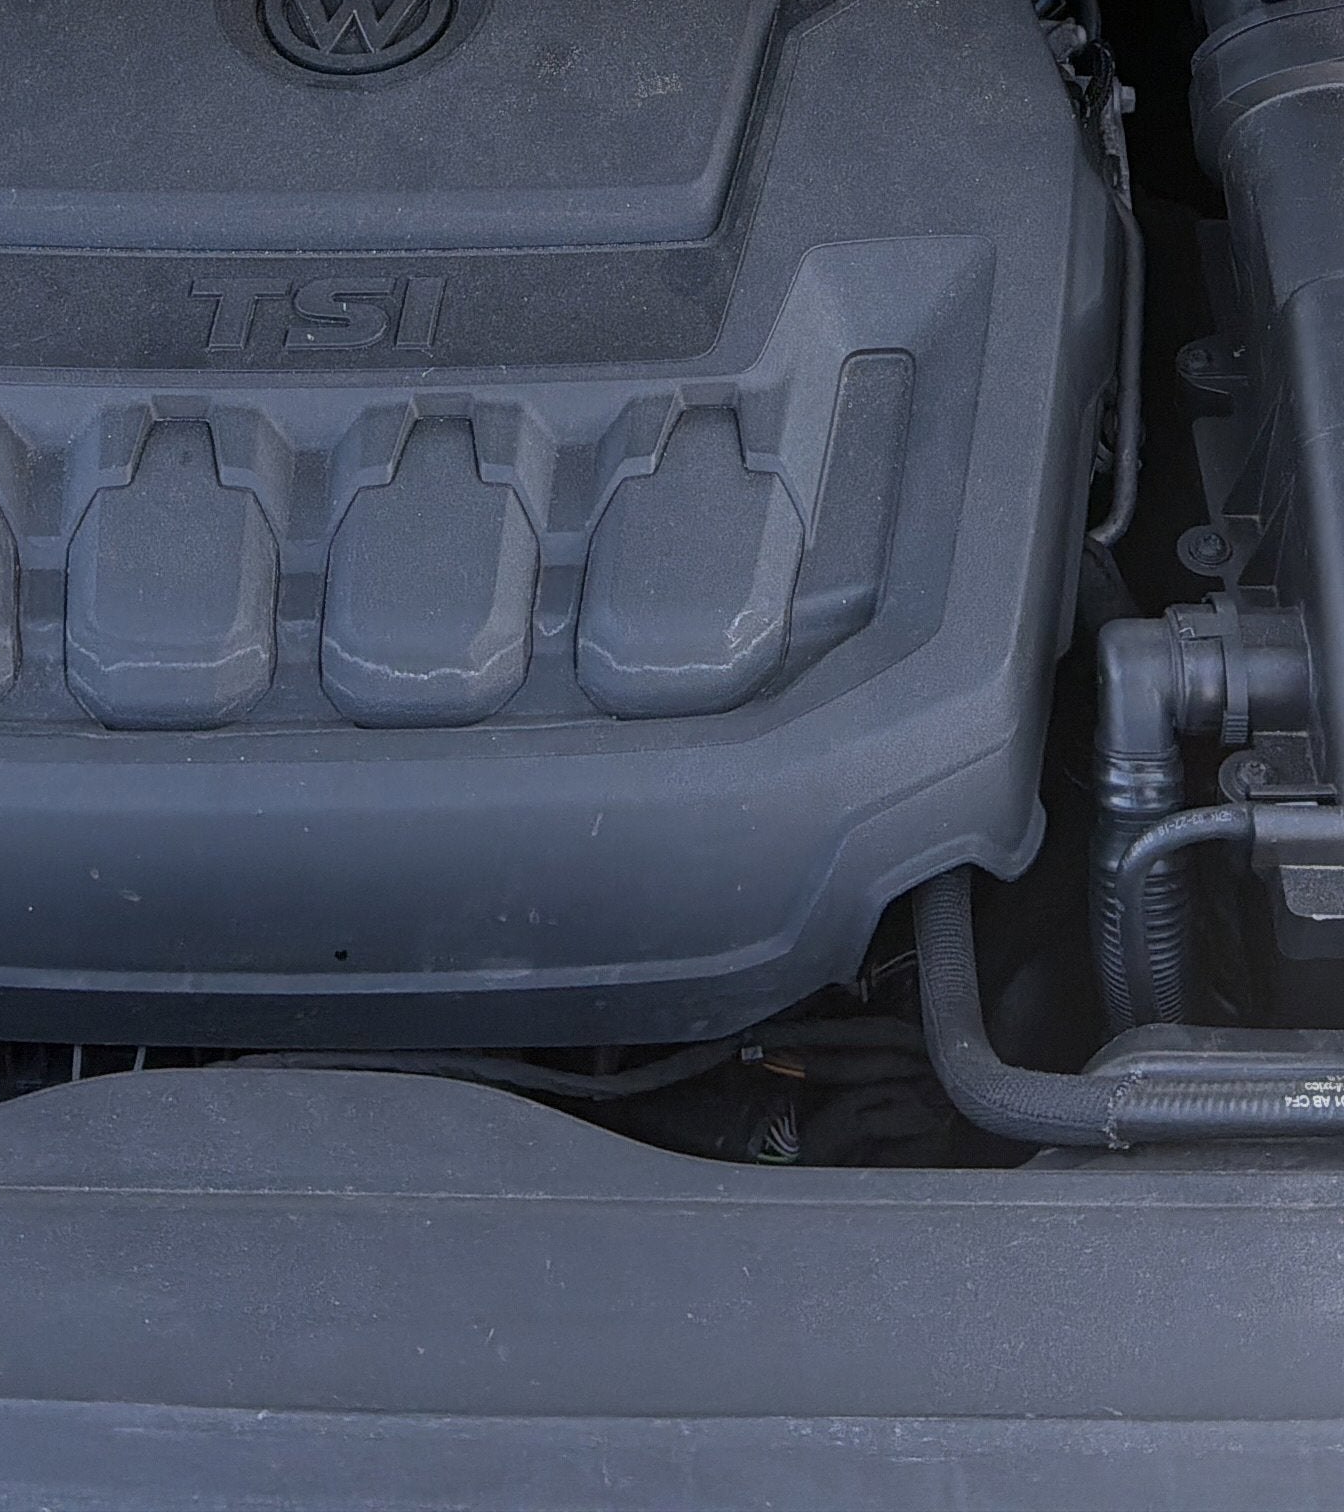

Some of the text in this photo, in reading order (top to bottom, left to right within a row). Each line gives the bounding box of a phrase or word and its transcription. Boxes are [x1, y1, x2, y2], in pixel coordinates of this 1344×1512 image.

[188, 276, 448, 350] TSI
[1281, 1094, 1307, 1106] CF4
[1309, 1094, 1328, 1106] AB
